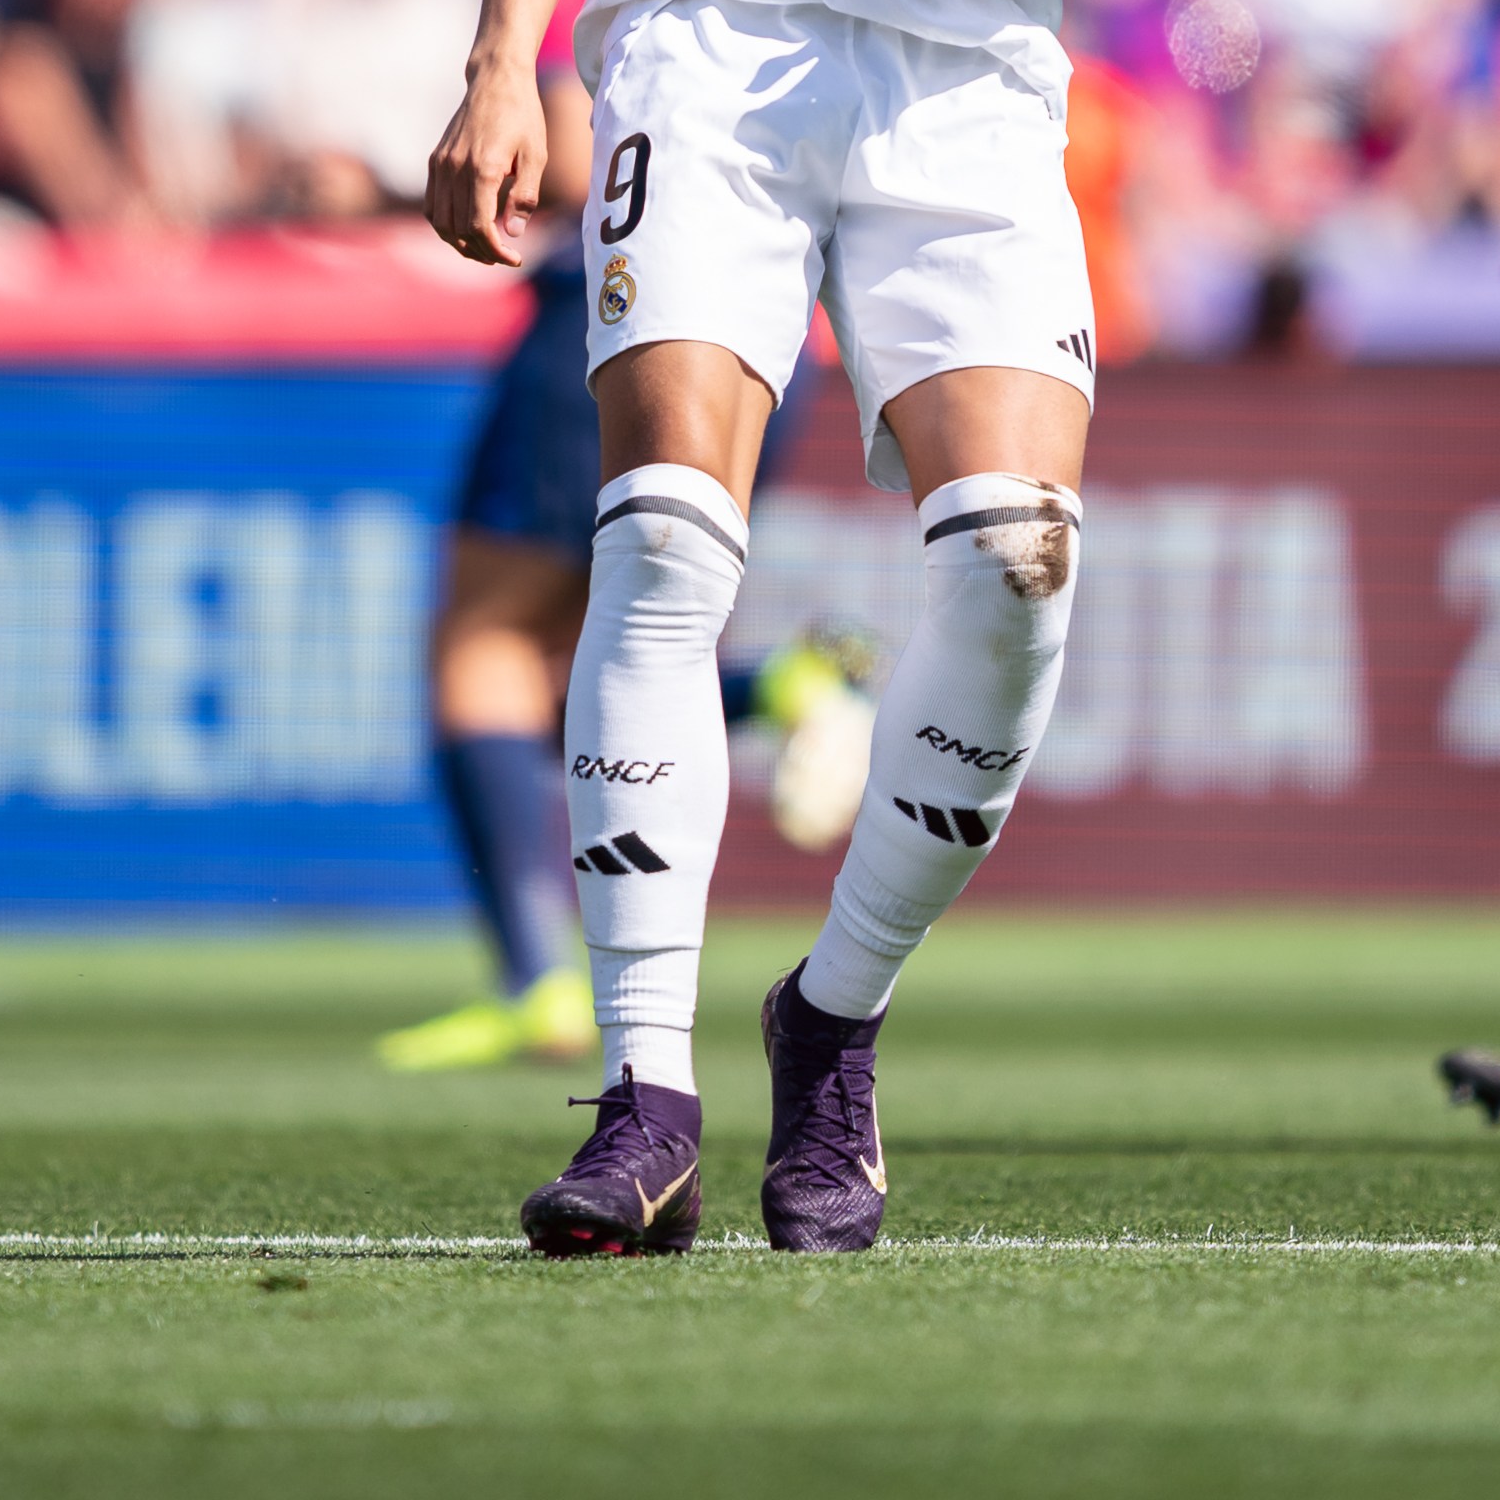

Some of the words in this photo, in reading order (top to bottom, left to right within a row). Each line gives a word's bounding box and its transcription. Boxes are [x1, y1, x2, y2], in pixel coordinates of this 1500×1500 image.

[600, 132, 651, 245] 9
[570, 754, 675, 784] RMCF
[915, 725, 1030, 771] RMCF
